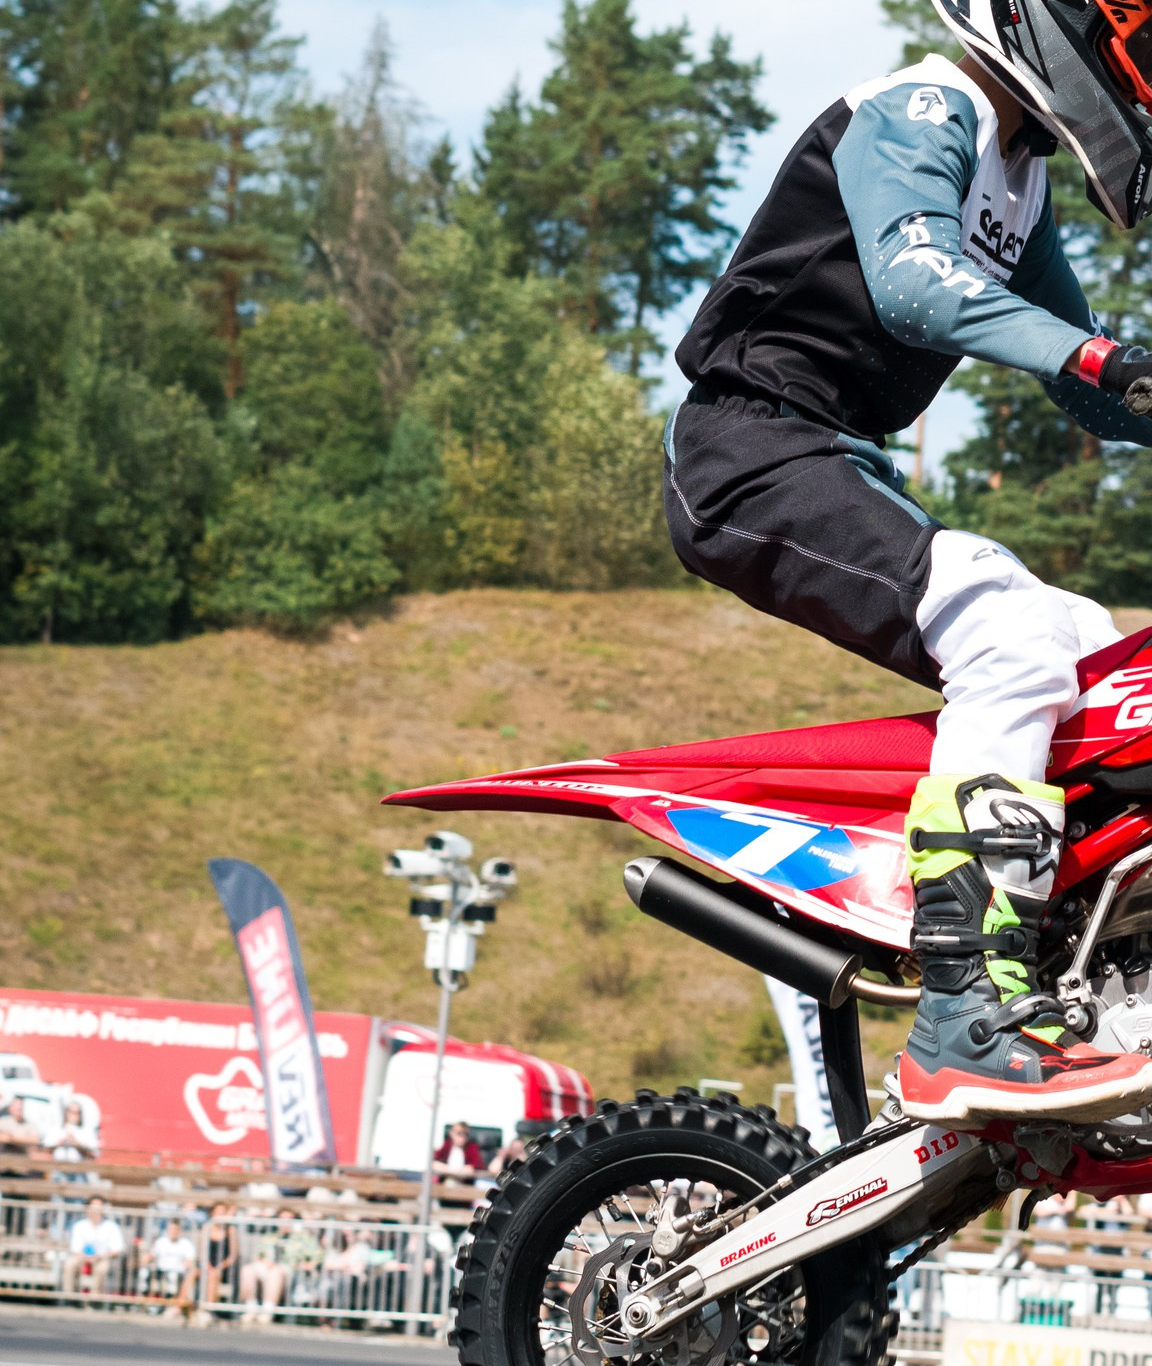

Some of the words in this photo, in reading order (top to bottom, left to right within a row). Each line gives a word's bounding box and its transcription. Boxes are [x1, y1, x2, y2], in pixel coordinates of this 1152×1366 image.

[1133, 163, 1146, 204] Airoh
[913, 1131, 960, 1165] D.I.D
[719, 1232, 777, 1268] BRAKING
